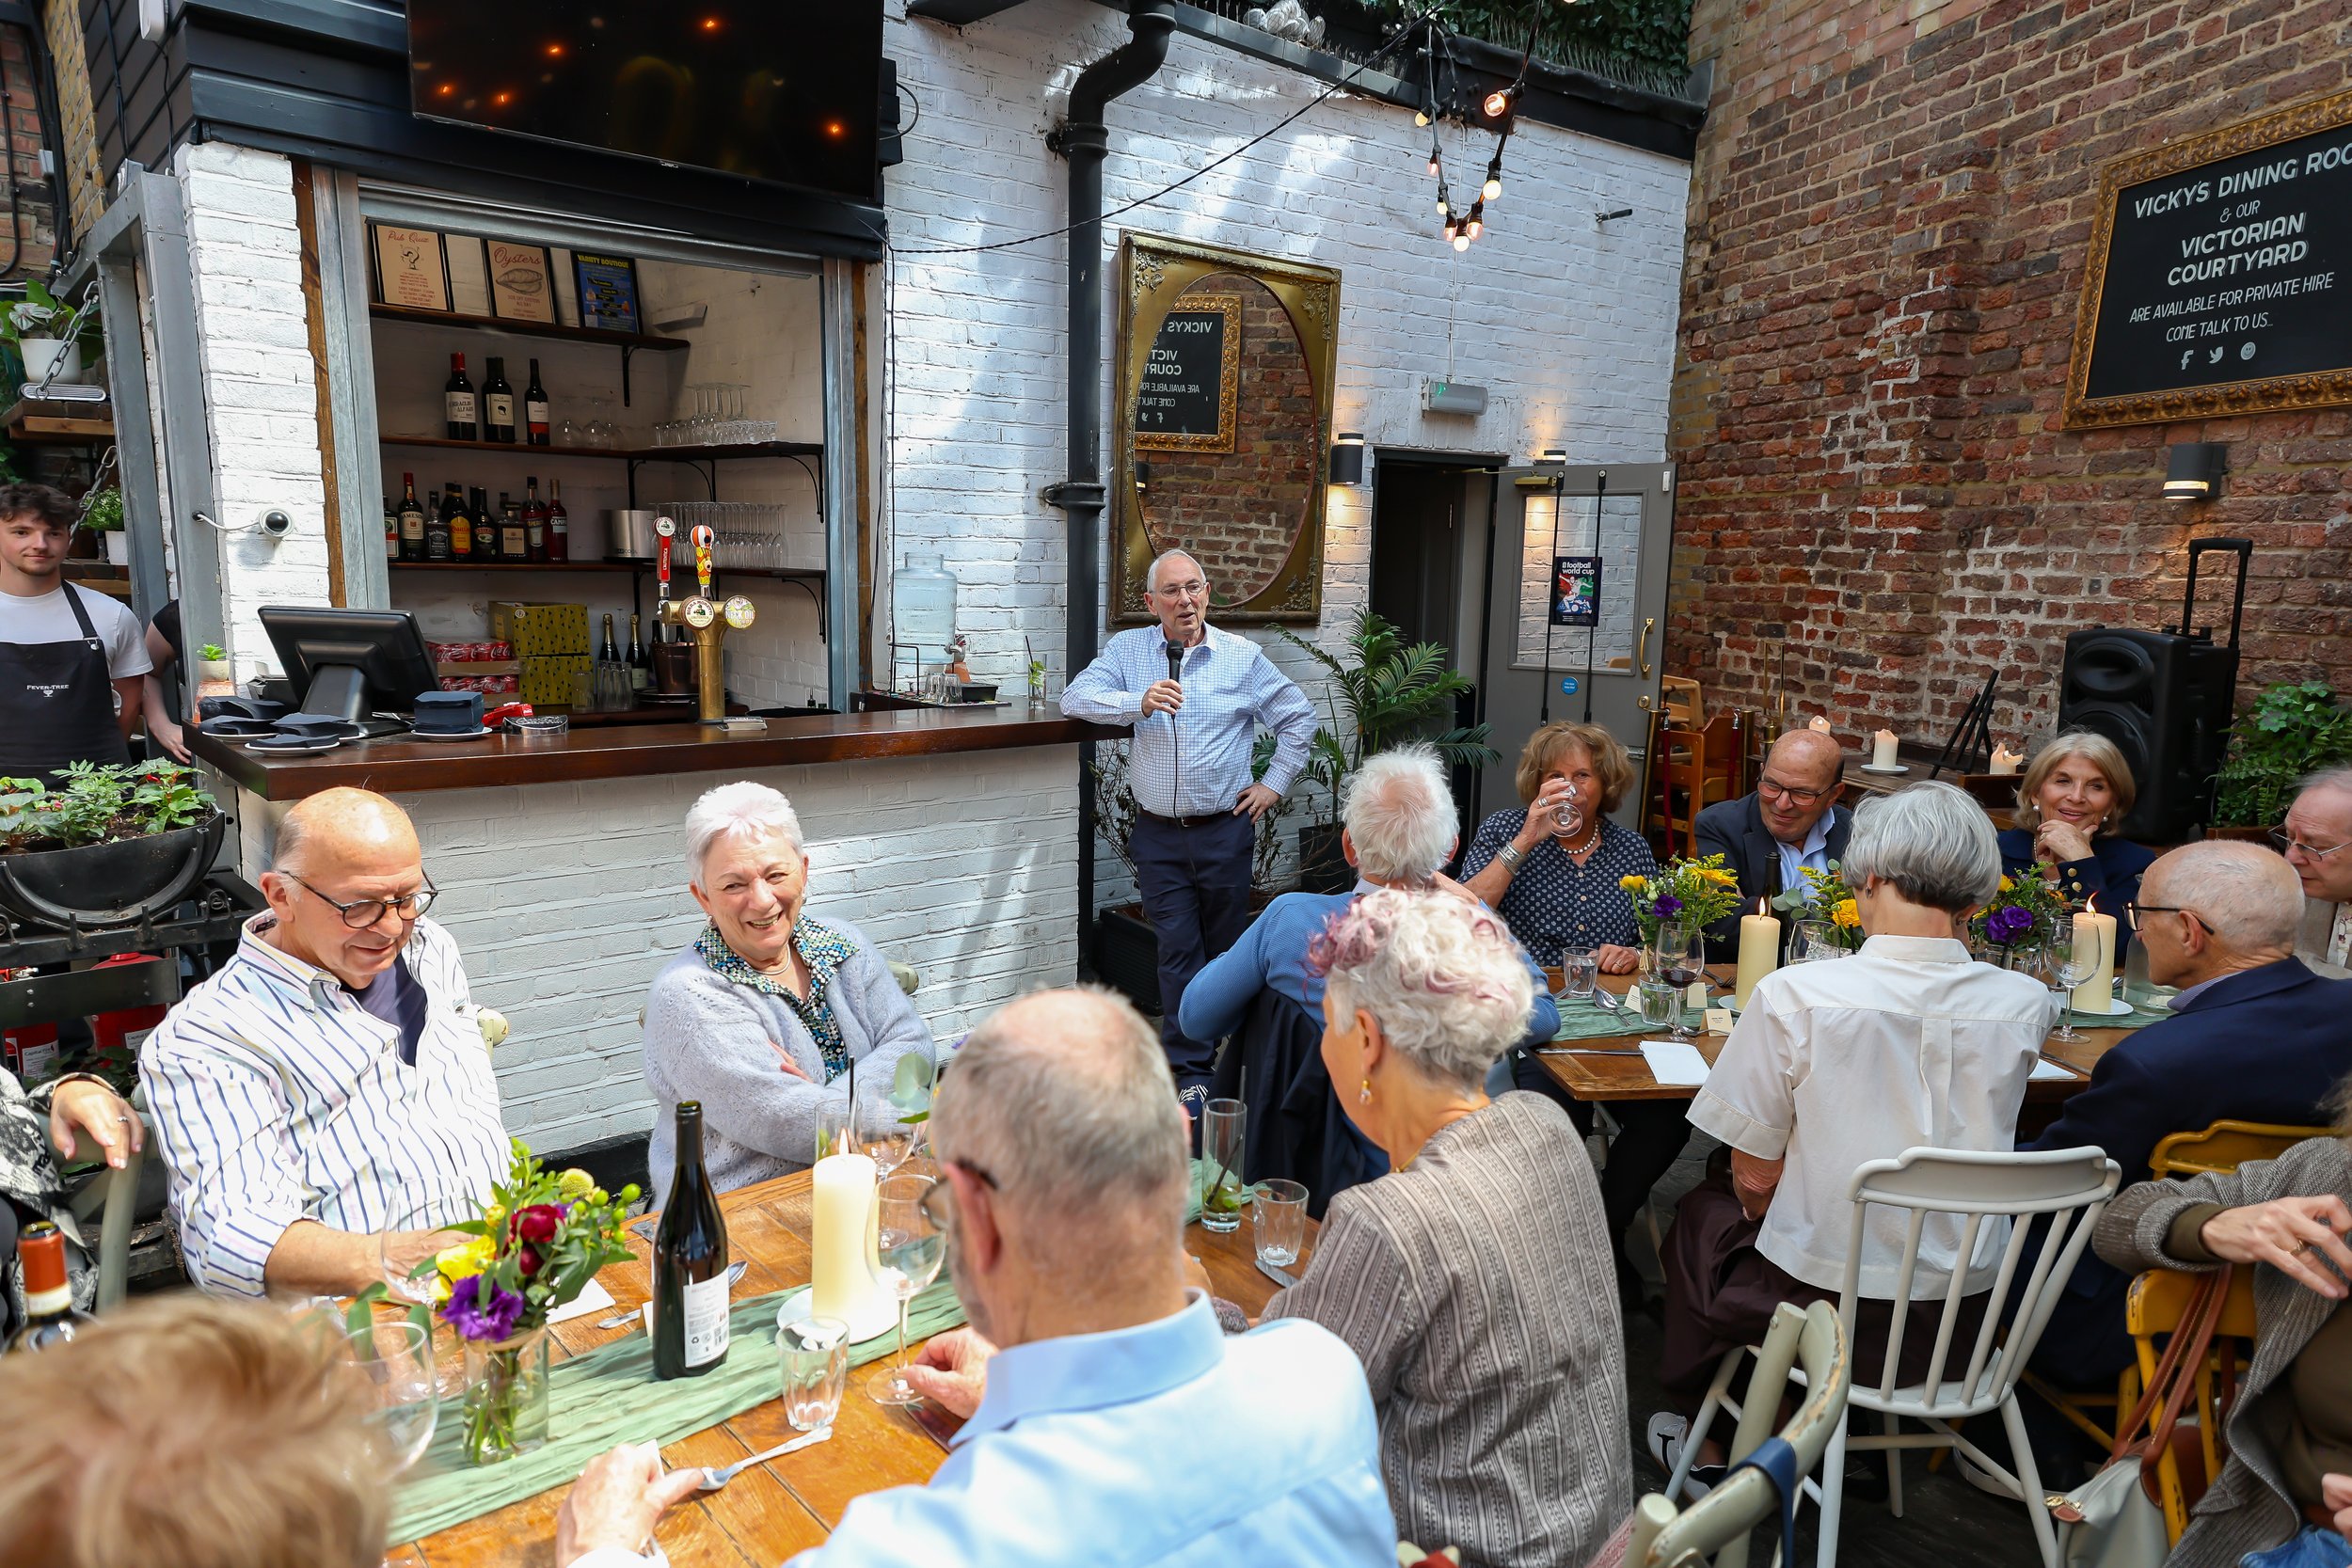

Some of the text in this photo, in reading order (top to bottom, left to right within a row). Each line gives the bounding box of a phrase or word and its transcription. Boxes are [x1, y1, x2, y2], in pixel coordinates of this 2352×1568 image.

[2135, 142, 2352, 219] VICKY'S DINING ROO
[2219, 199, 2261, 223] & OUR
[2181, 212, 2307, 259] VICTORIAN
[494, 246, 541, 268] Oysters
[578, 254, 629, 269] VARIETY BOUTIQUE
[2167, 240, 2309, 286] COURTYARD
[2129, 271, 2335, 324] ARE AVAILABLE FOR PRIVATE HIRE
[2166, 324, 2197, 342] COME
[2200, 317, 2232, 337] TALK
[2233, 315, 2249, 332] TO
